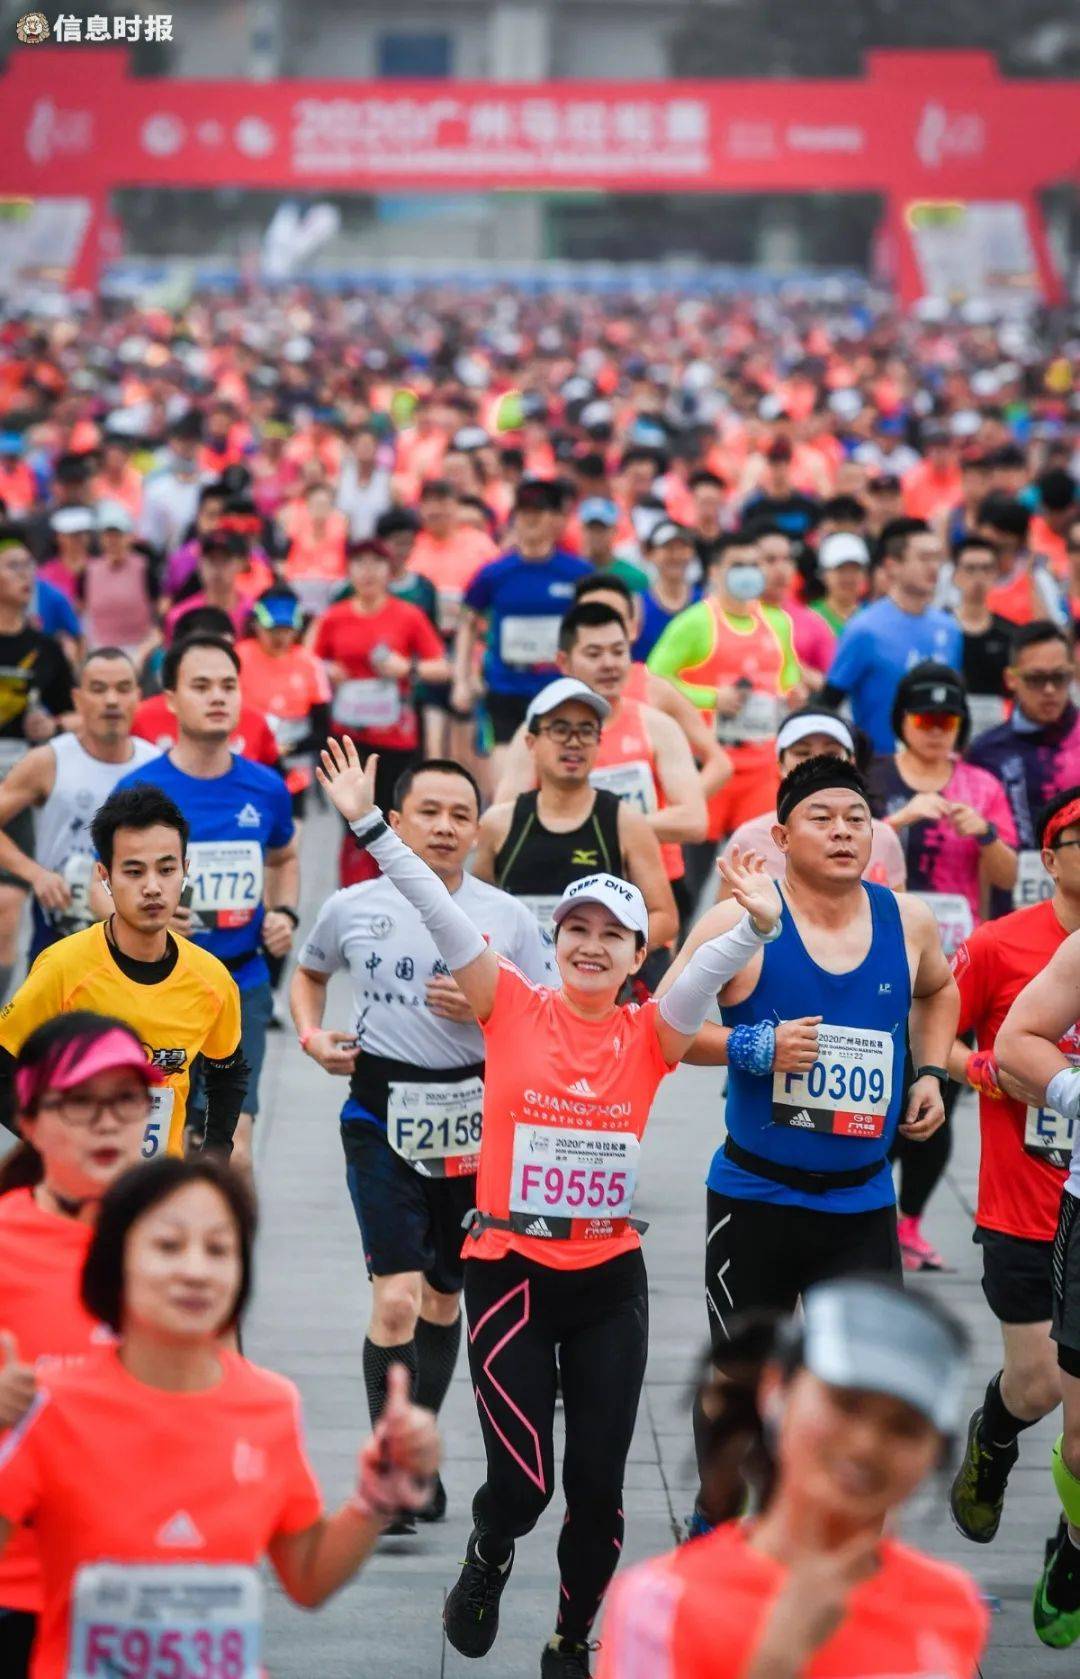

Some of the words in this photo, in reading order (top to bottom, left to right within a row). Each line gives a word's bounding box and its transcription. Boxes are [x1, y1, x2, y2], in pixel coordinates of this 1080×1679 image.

[569, 878, 599, 897] DEEP
[604, 879, 634, 902] DIVE
[785, 1061, 885, 1104] F0309
[523, 1088, 632, 1119] GUANGZHOU
[523, 1106, 593, 1127] MARATHON
[396, 1112, 483, 1150] F2158
[521, 1164, 627, 1208] F9555
[85, 1623, 245, 1679] F9538
